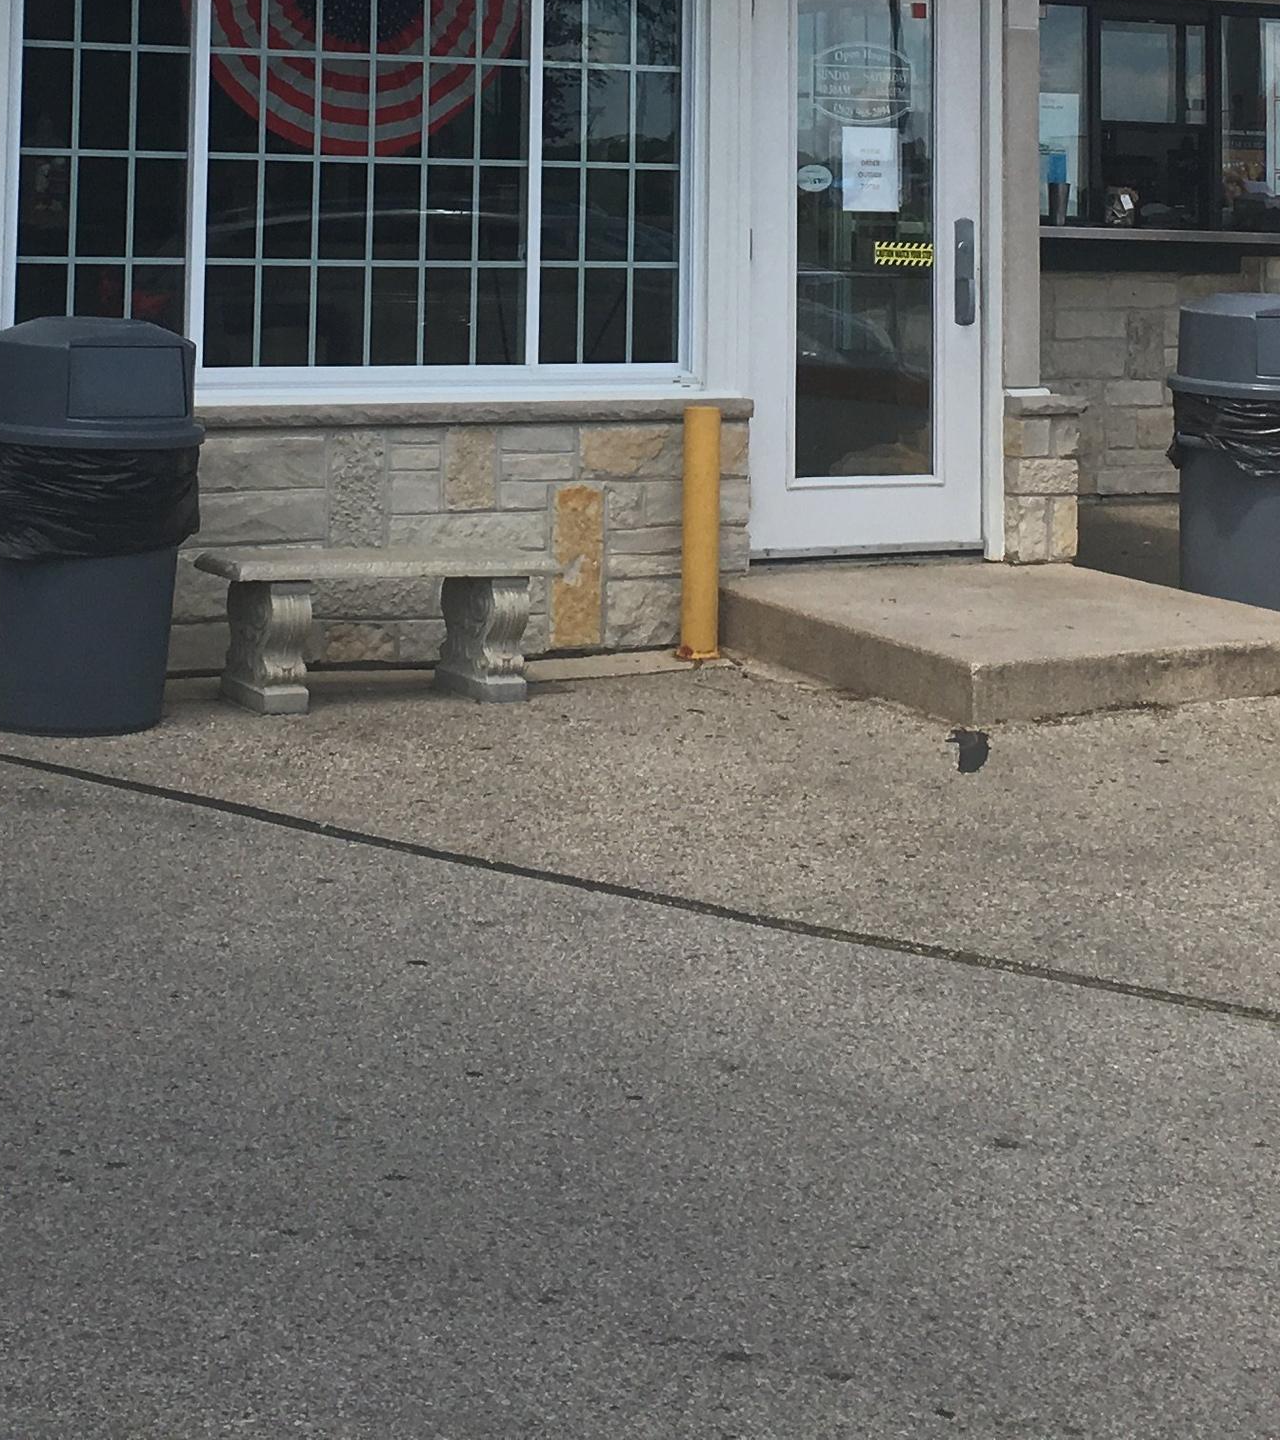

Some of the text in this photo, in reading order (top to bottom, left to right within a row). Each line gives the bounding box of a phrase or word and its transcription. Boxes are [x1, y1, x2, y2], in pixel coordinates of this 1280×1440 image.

[876, 249, 932, 259] CAUTION WATCH YOUR STEP
